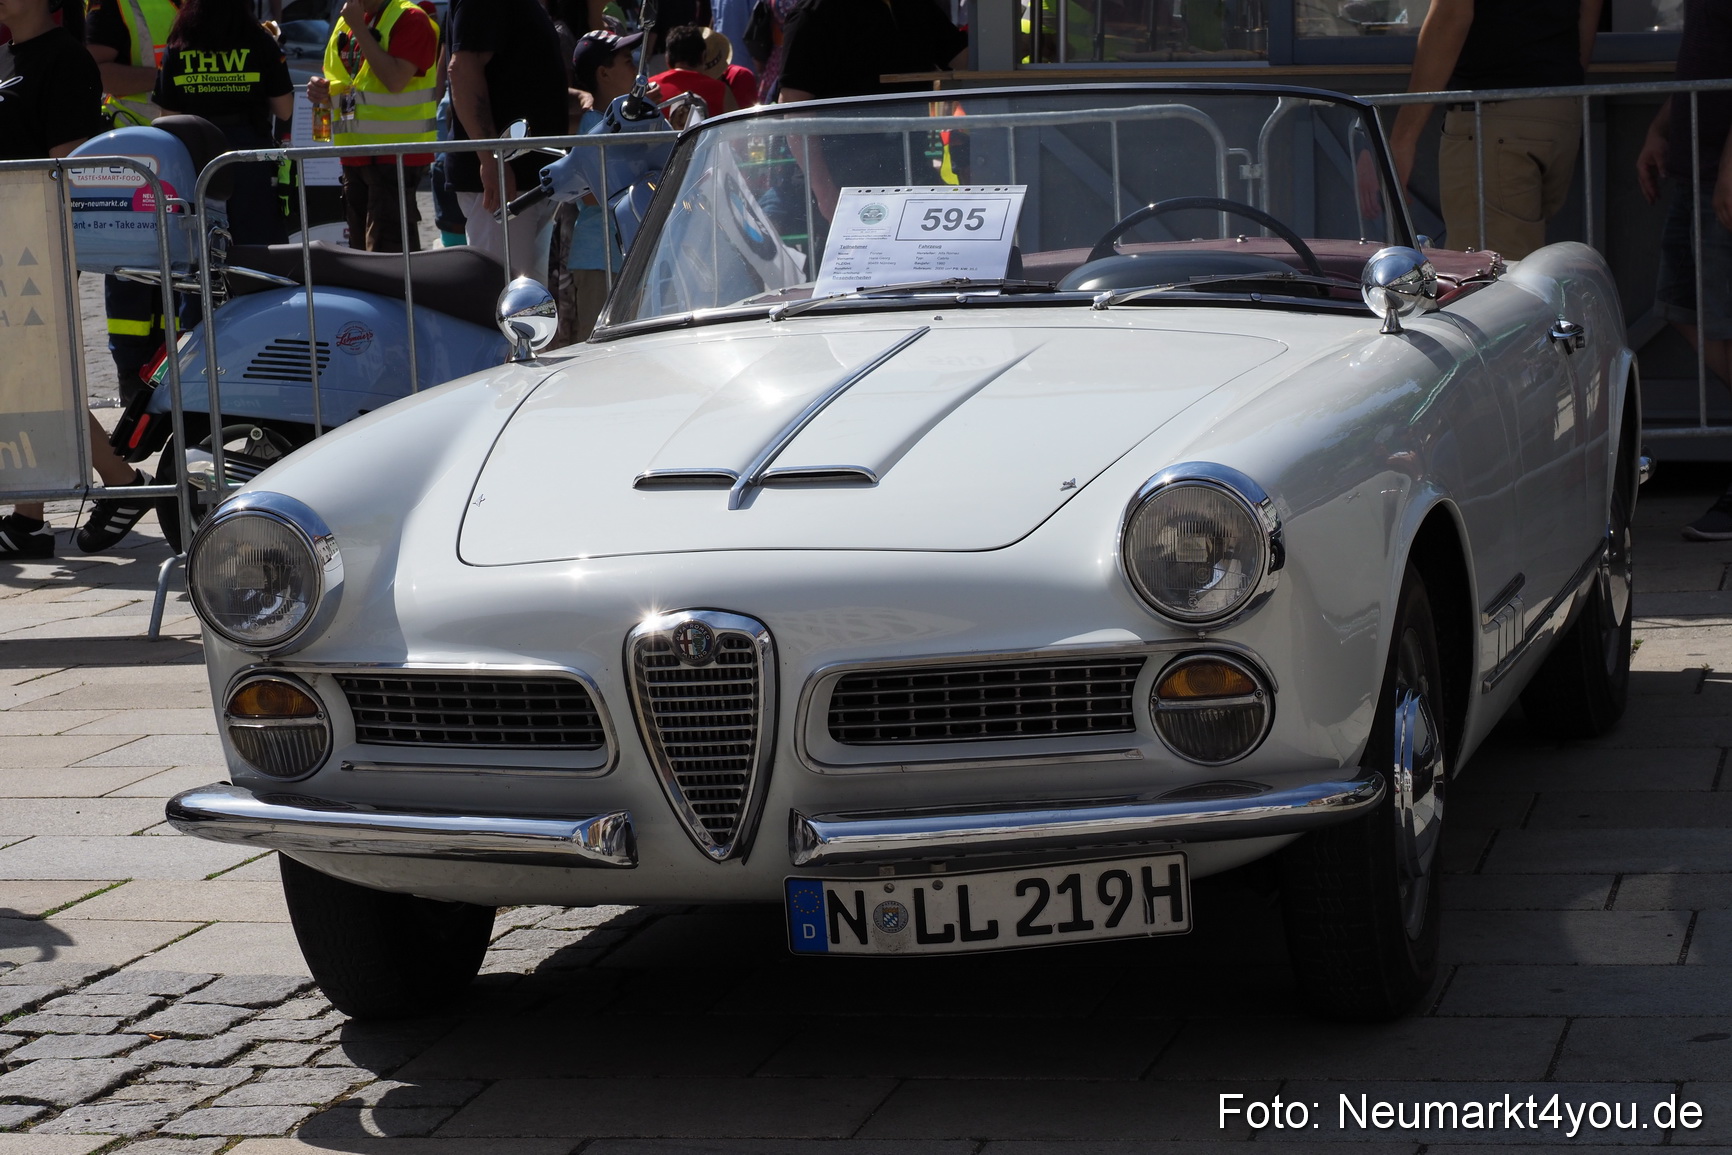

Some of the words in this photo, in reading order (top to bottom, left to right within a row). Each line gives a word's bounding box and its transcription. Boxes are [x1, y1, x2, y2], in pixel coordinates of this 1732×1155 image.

[180, 49, 250, 73] THW
[186, 75, 199, 83] OV
[201, 74, 246, 82] Neumarkt
[93, 221, 106, 229] Bar
[115, 221, 135, 229] Take
[920, 207, 986, 231] 595
[690, 624, 711, 640] ROMEO
[826, 889, 868, 945] N
[914, 884, 999, 944] LL
[1016, 863, 1184, 938] 219H
[803, 924, 816, 939] D
